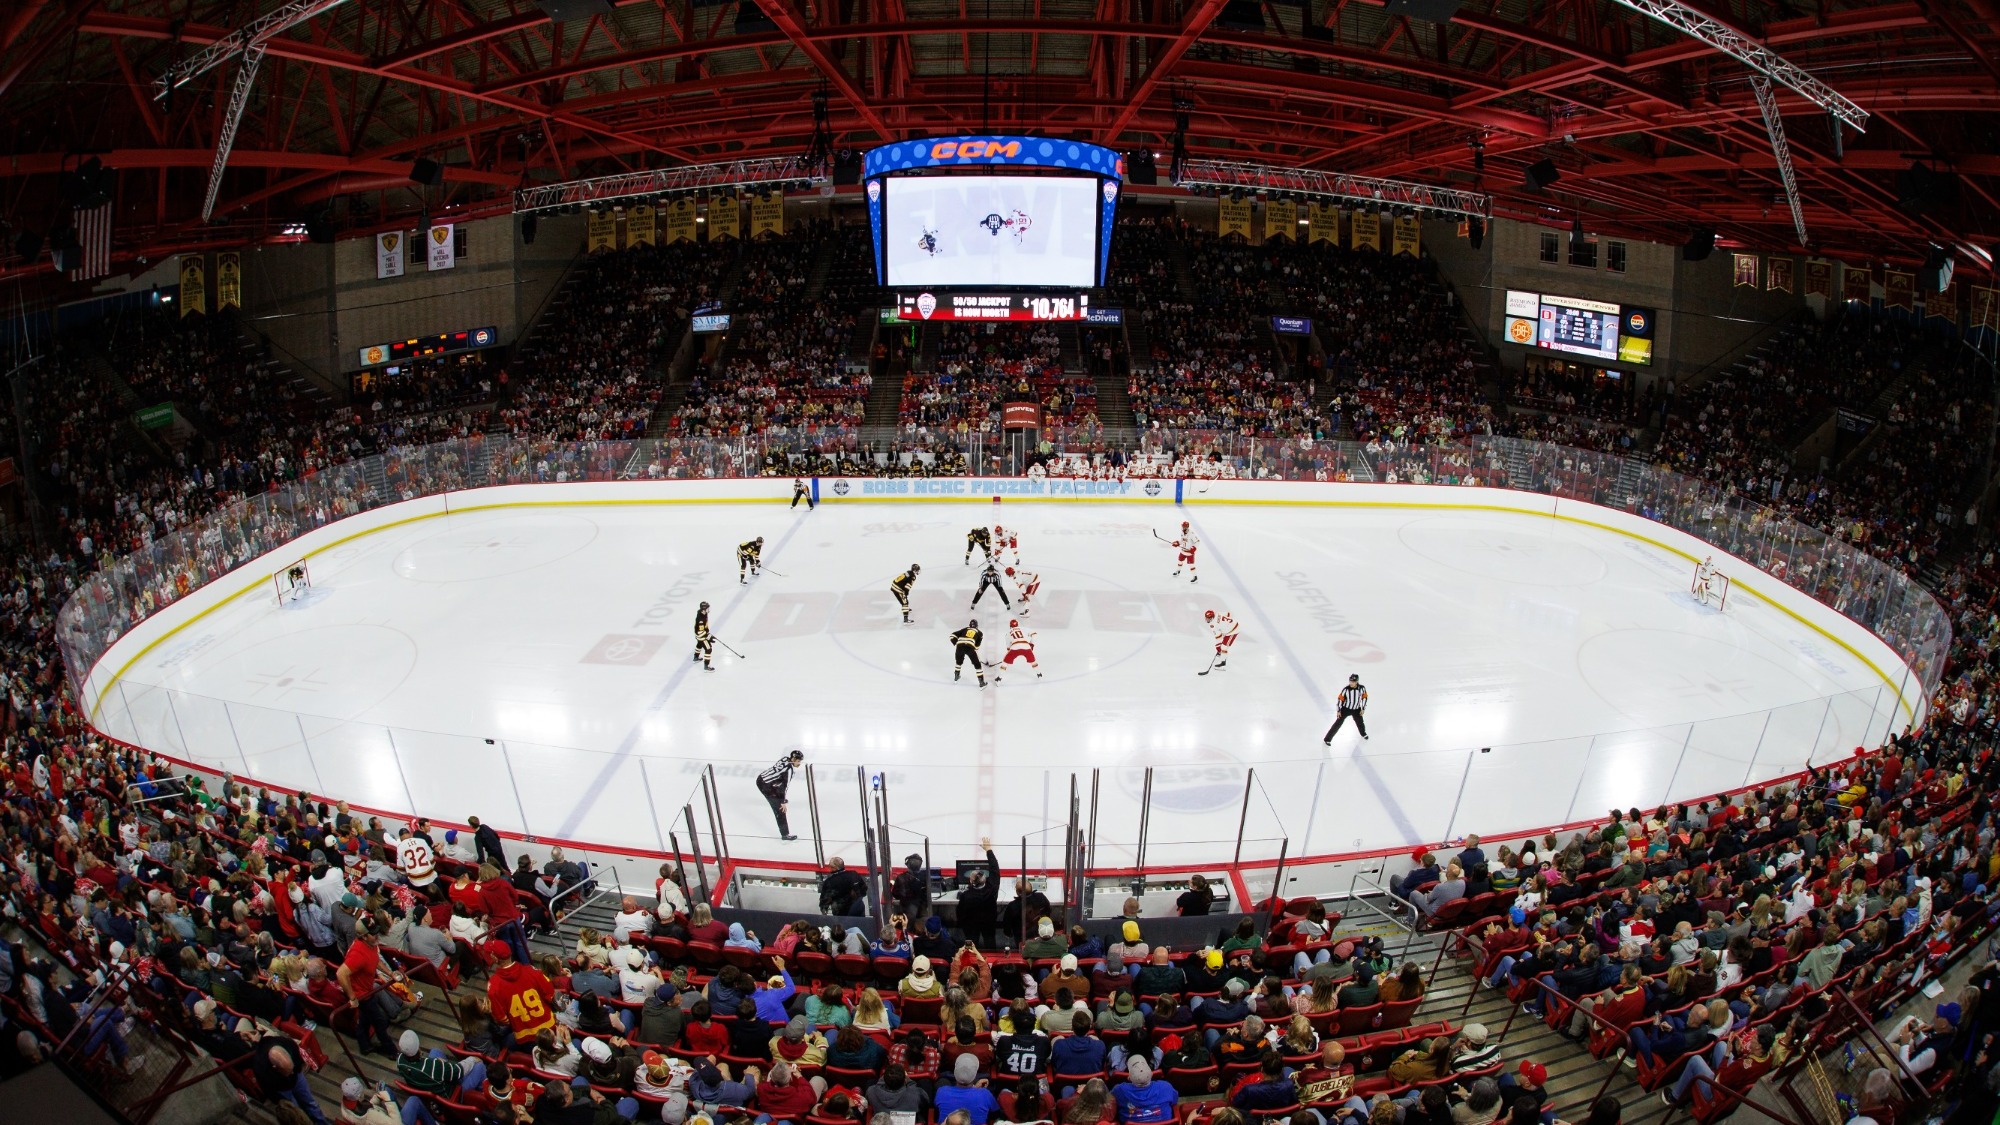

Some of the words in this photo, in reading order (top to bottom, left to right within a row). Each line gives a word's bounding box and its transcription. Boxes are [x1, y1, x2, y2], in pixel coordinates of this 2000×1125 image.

[931, 141, 1020, 159] CCM
[953, 297, 977, 306] 50/50
[978, 297, 1011, 306] JACKPOT
[1545, 297, 1581, 306] UNIVERSITY
[954, 308, 962, 317] IS
[963, 308, 981, 317] NOW
[982, 308, 1010, 317] WORTH
[1280, 318, 1303, 326] Quantum
[1006, 406, 1035, 414] DENVER
[914, 480, 965, 494] NCHC
[971, 480, 1045, 494] FROZEN
[1051, 480, 1132, 494] FACEOFF
[632, 571, 711, 628] TOYOTA
[1273, 571, 1364, 638] SAFEWAY
[741, 589, 1261, 642] DENVER
[1010, 630, 1024, 640] 10
[1126, 767, 1242, 784] PEPSI
[404, 846, 429, 870] 32
[509, 988, 545, 1022] 49
[1006, 1052, 1037, 1073] 40
